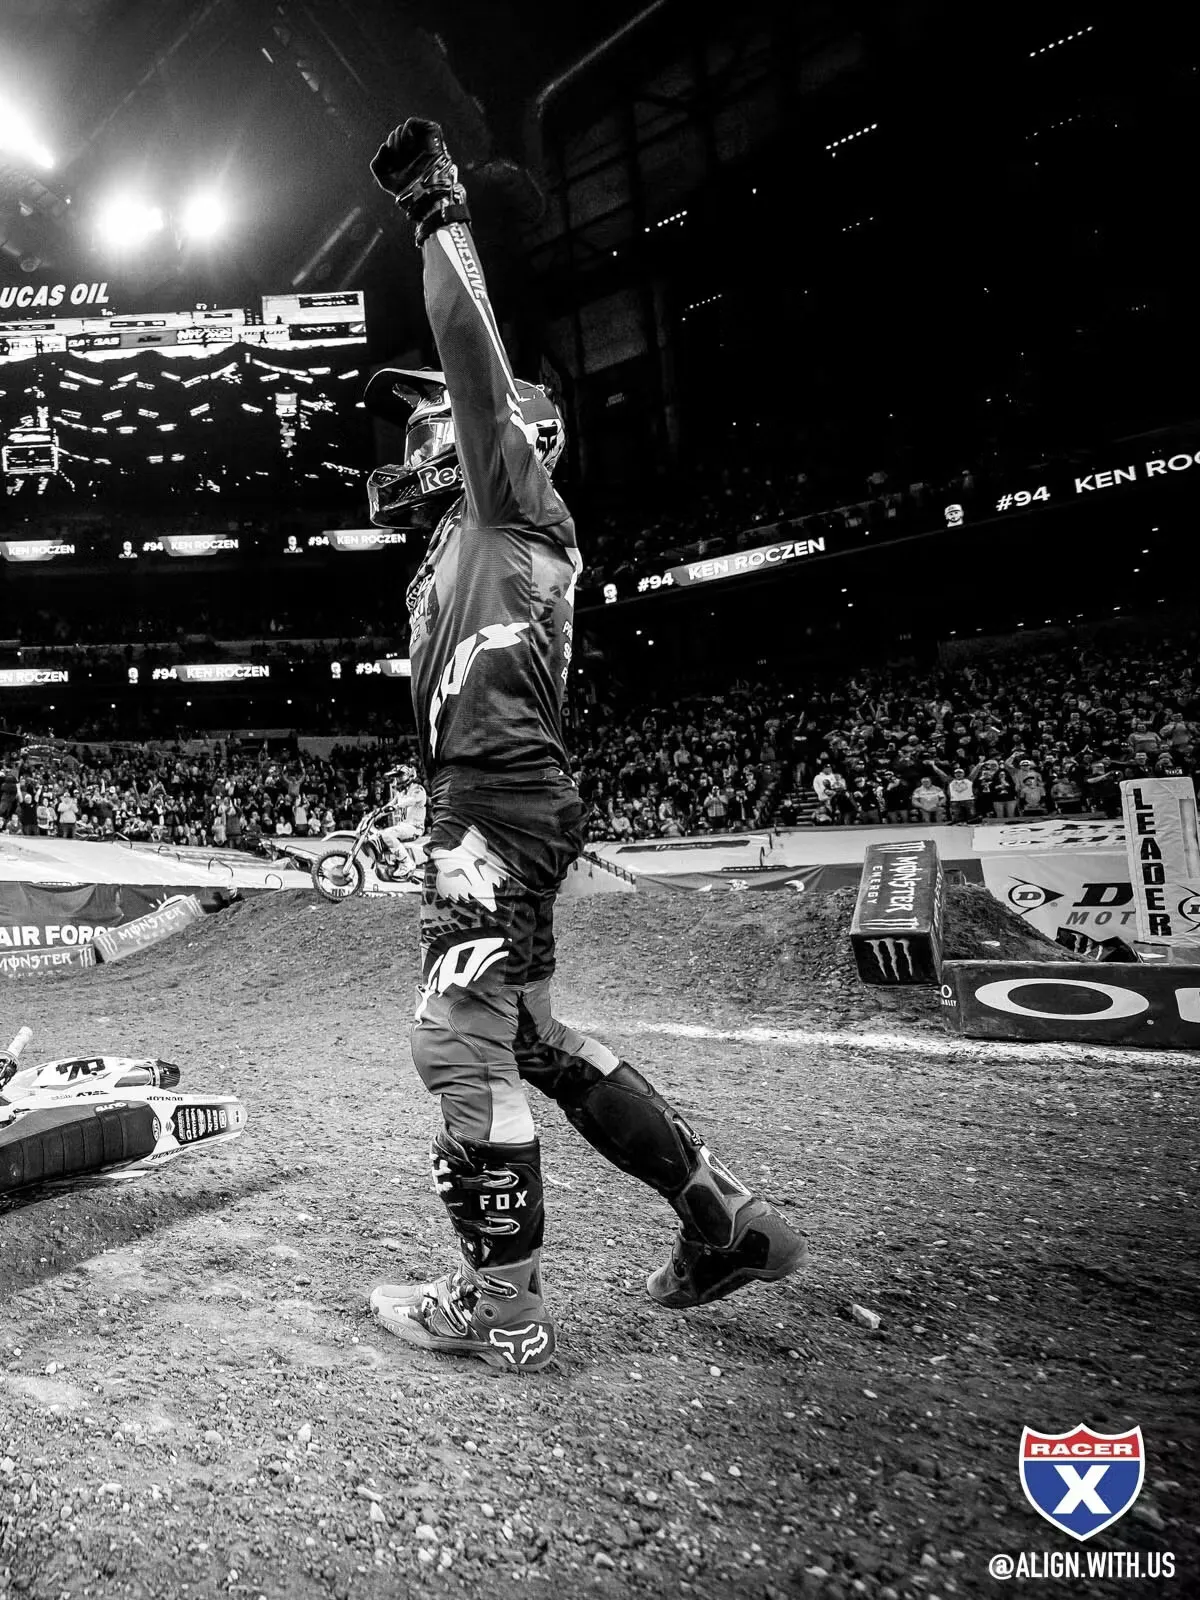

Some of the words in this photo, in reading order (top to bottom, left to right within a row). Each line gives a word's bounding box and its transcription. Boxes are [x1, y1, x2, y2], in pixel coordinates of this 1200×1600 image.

[70, 282, 109, 304] OIL
[996, 486, 1051, 511] #94
[1074, 465, 1137, 493] KEN
[1145, 450, 1200, 477] RO
[143, 542, 164, 551] #94
[171, 541, 193, 551] KEN
[195, 539, 239, 550] ROCZEN
[308, 536, 329, 546] #94
[337, 535, 359, 545] KEN
[361, 533, 406, 544] ROCZEN
[8, 547, 30, 556] KEN
[32, 545, 75, 555] ROCZEN
[637, 572, 674, 593] #94
[688, 560, 729, 580] KEN
[735, 537, 826, 570] ROCZEN
[16, 670, 69, 683] ROCZEN
[152, 668, 177, 680] #94
[187, 667, 213, 679] KEN
[216, 665, 270, 678] ROCZEN
[355, 663, 381, 675] #94
[391, 661, 412, 674] KE
[1133, 787, 1172, 937] LEADER
[867, 865, 883, 904] ENERGY
[885, 856, 923, 913] MONSTER
[1072, 883, 1134, 907] D
[117, 906, 185, 941] MONSTER
[1066, 911, 1135, 925] MOT
[479, 1190, 528, 1210] FOX
